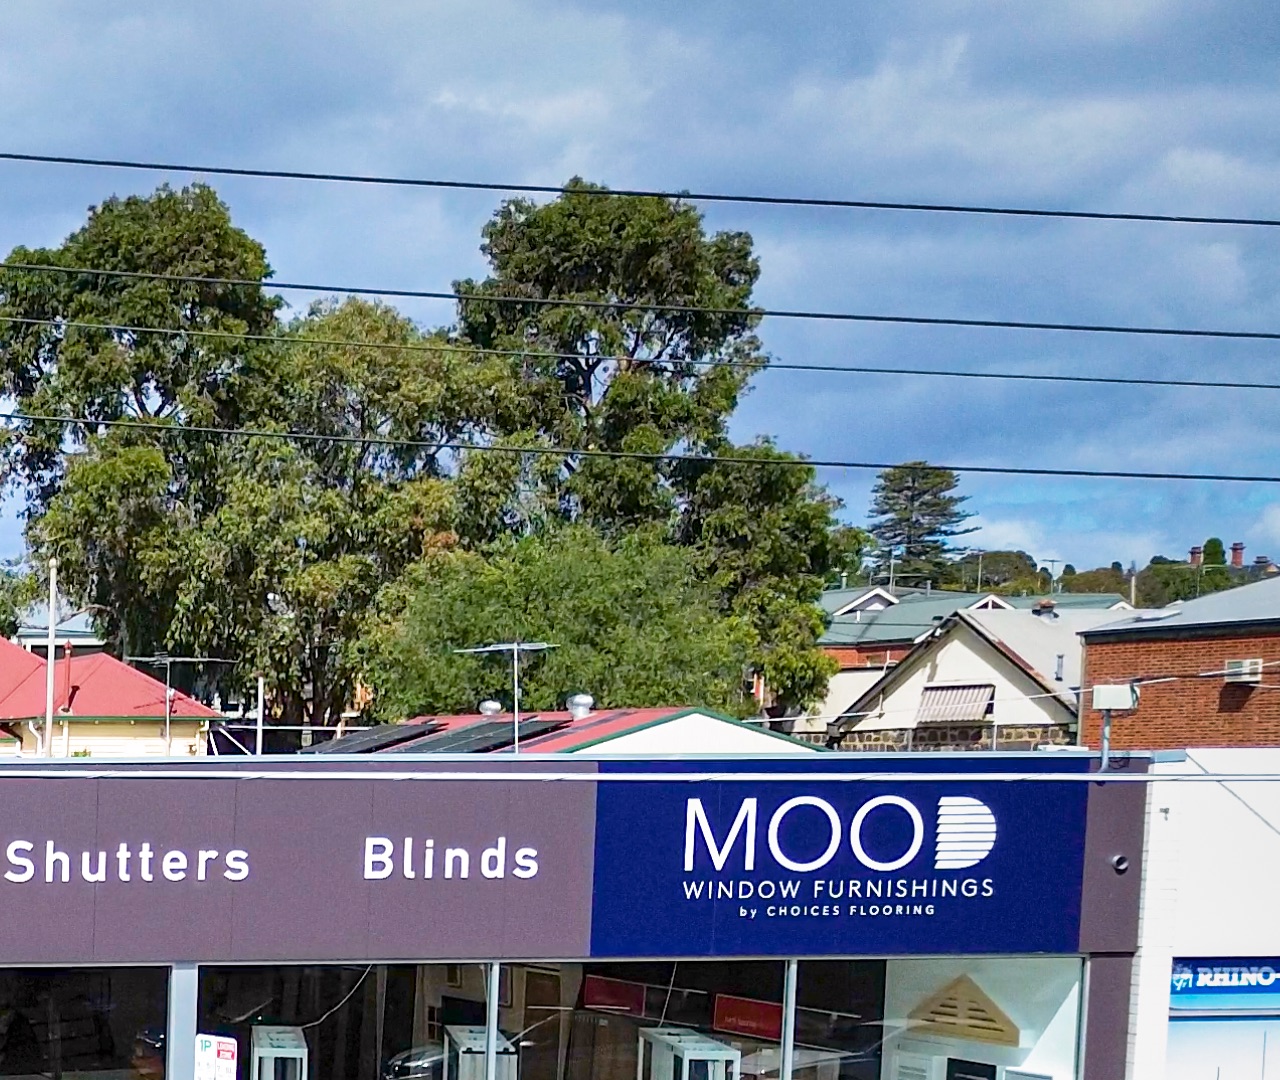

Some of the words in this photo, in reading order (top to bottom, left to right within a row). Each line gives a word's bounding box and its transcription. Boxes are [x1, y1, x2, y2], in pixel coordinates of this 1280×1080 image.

[3, 839, 250, 883] Shutters
[363, 836, 540, 880] Blinds
[683, 880, 801, 900] WINDOW
[814, 878, 994, 899] FURNISHINGS
[739, 905, 757, 919] by
[767, 905, 840, 917] CHOICES
[849, 904, 935, 916] FLOORING
[200, 1039, 212, 1052] 1P
